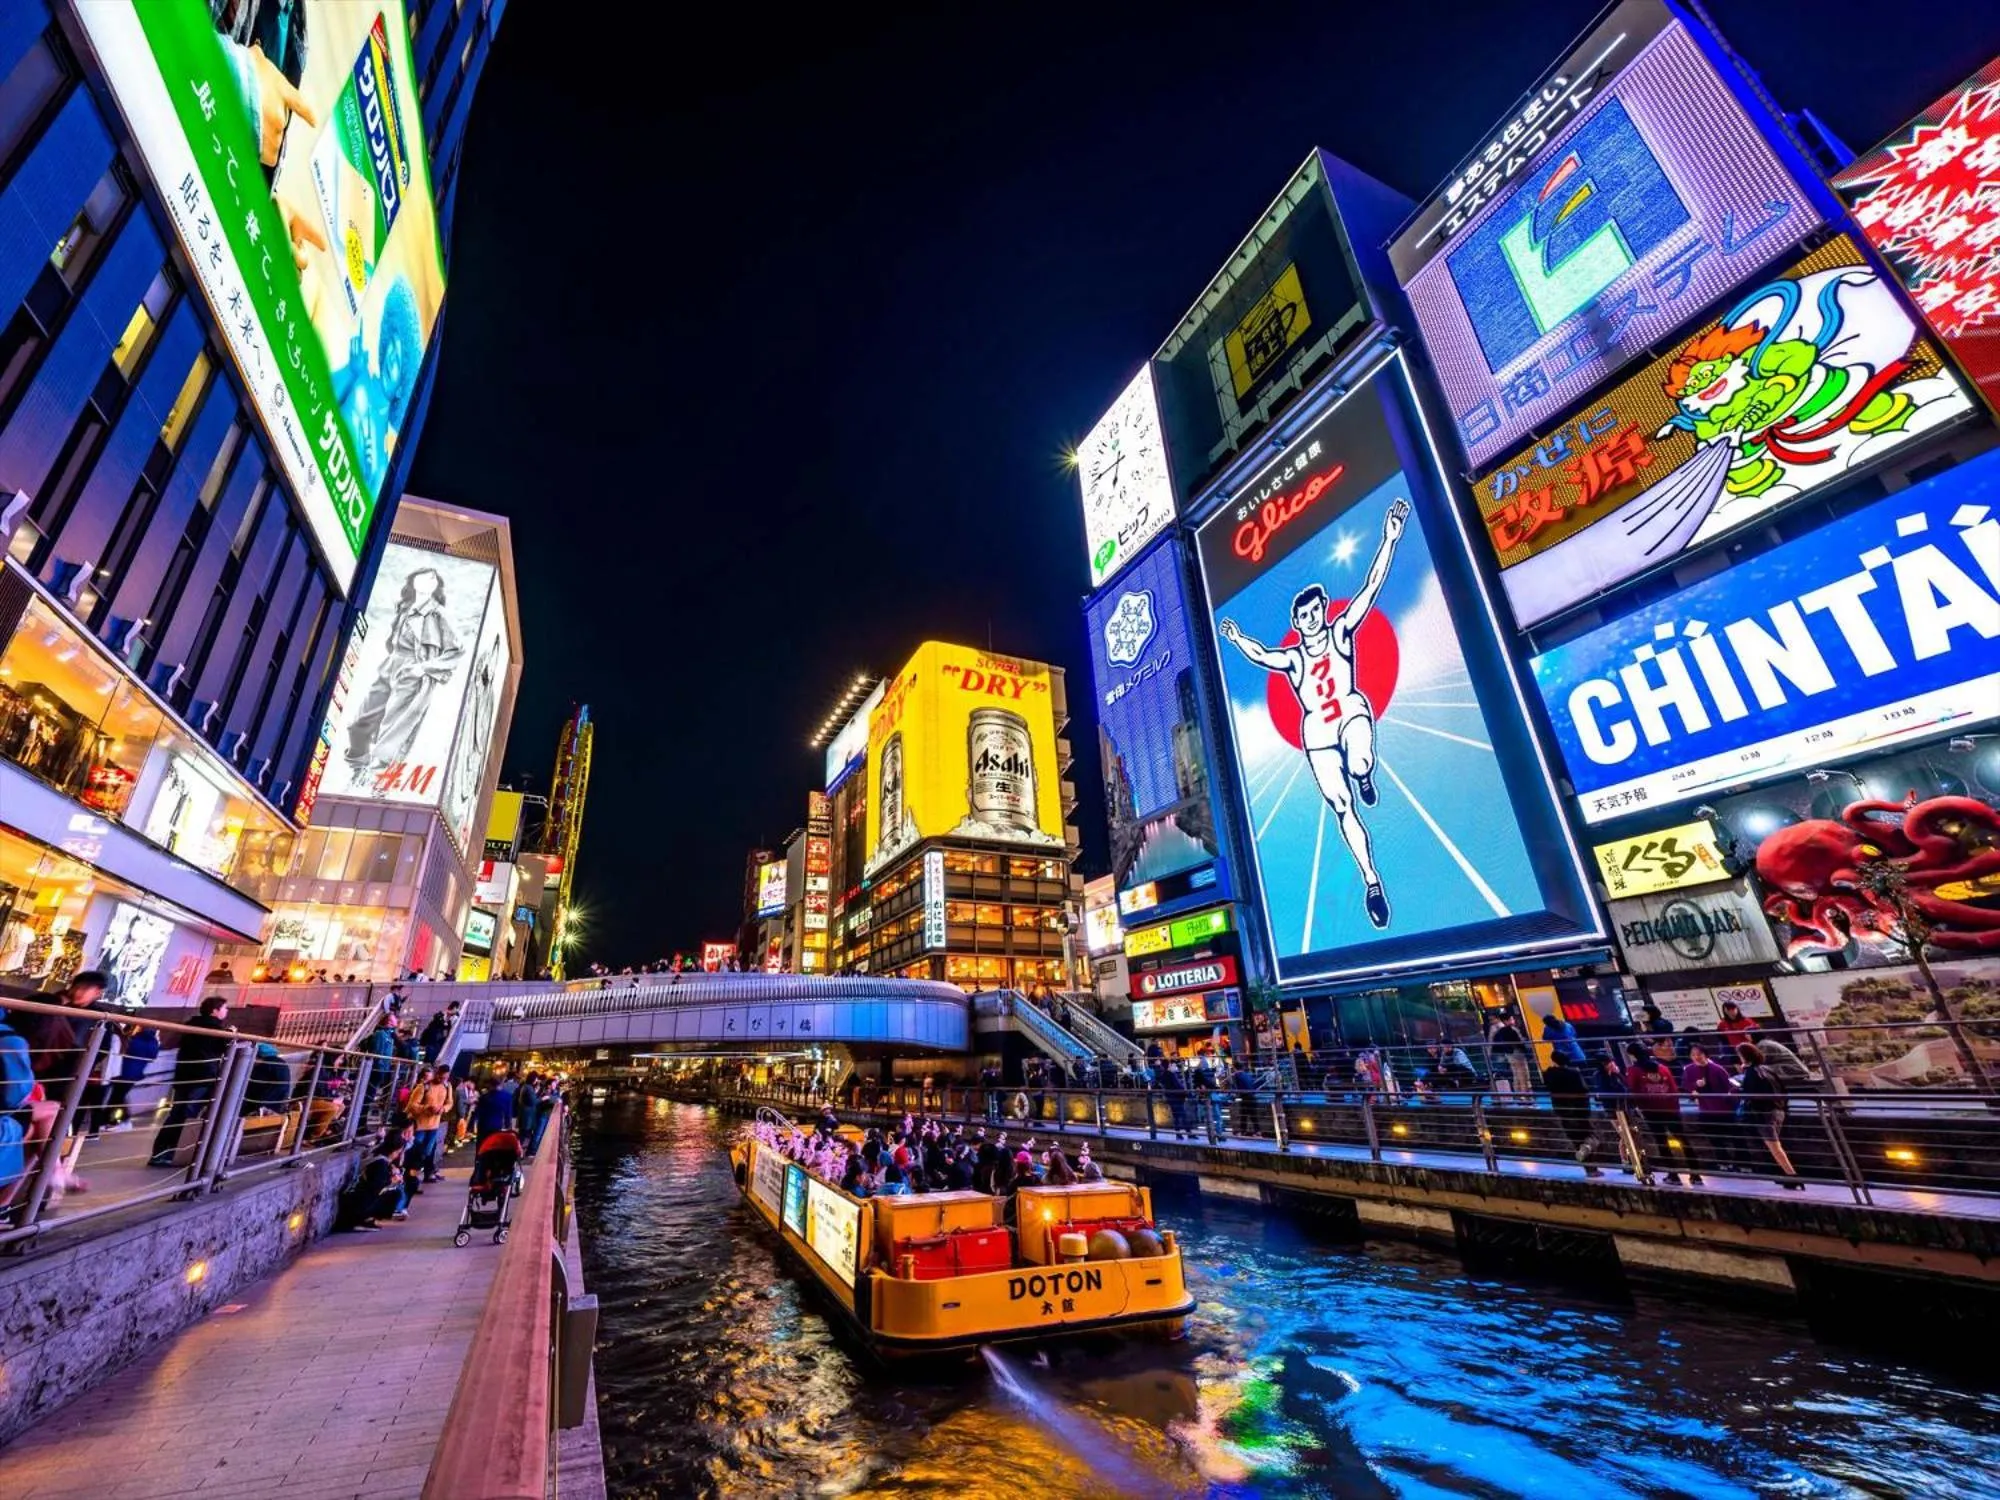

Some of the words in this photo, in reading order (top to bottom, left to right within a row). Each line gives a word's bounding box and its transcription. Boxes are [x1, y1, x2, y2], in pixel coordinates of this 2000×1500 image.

[1489, 407, 1620, 500] かぜに
[1237, 440, 1322, 520] おいしさと健康
[1485, 421, 1656, 551] 改源
[1118, 502, 1150, 546] ピップ
[1311, 652, 1342, 723] グリコ
[975, 748, 1029, 778] Asahi
[1593, 787, 1649, 813] 天気予報
[1622, 837, 1697, 879] くくる
[1157, 966, 1218, 989] LOTTERIA
[1008, 1269, 1102, 1300] DOTON
